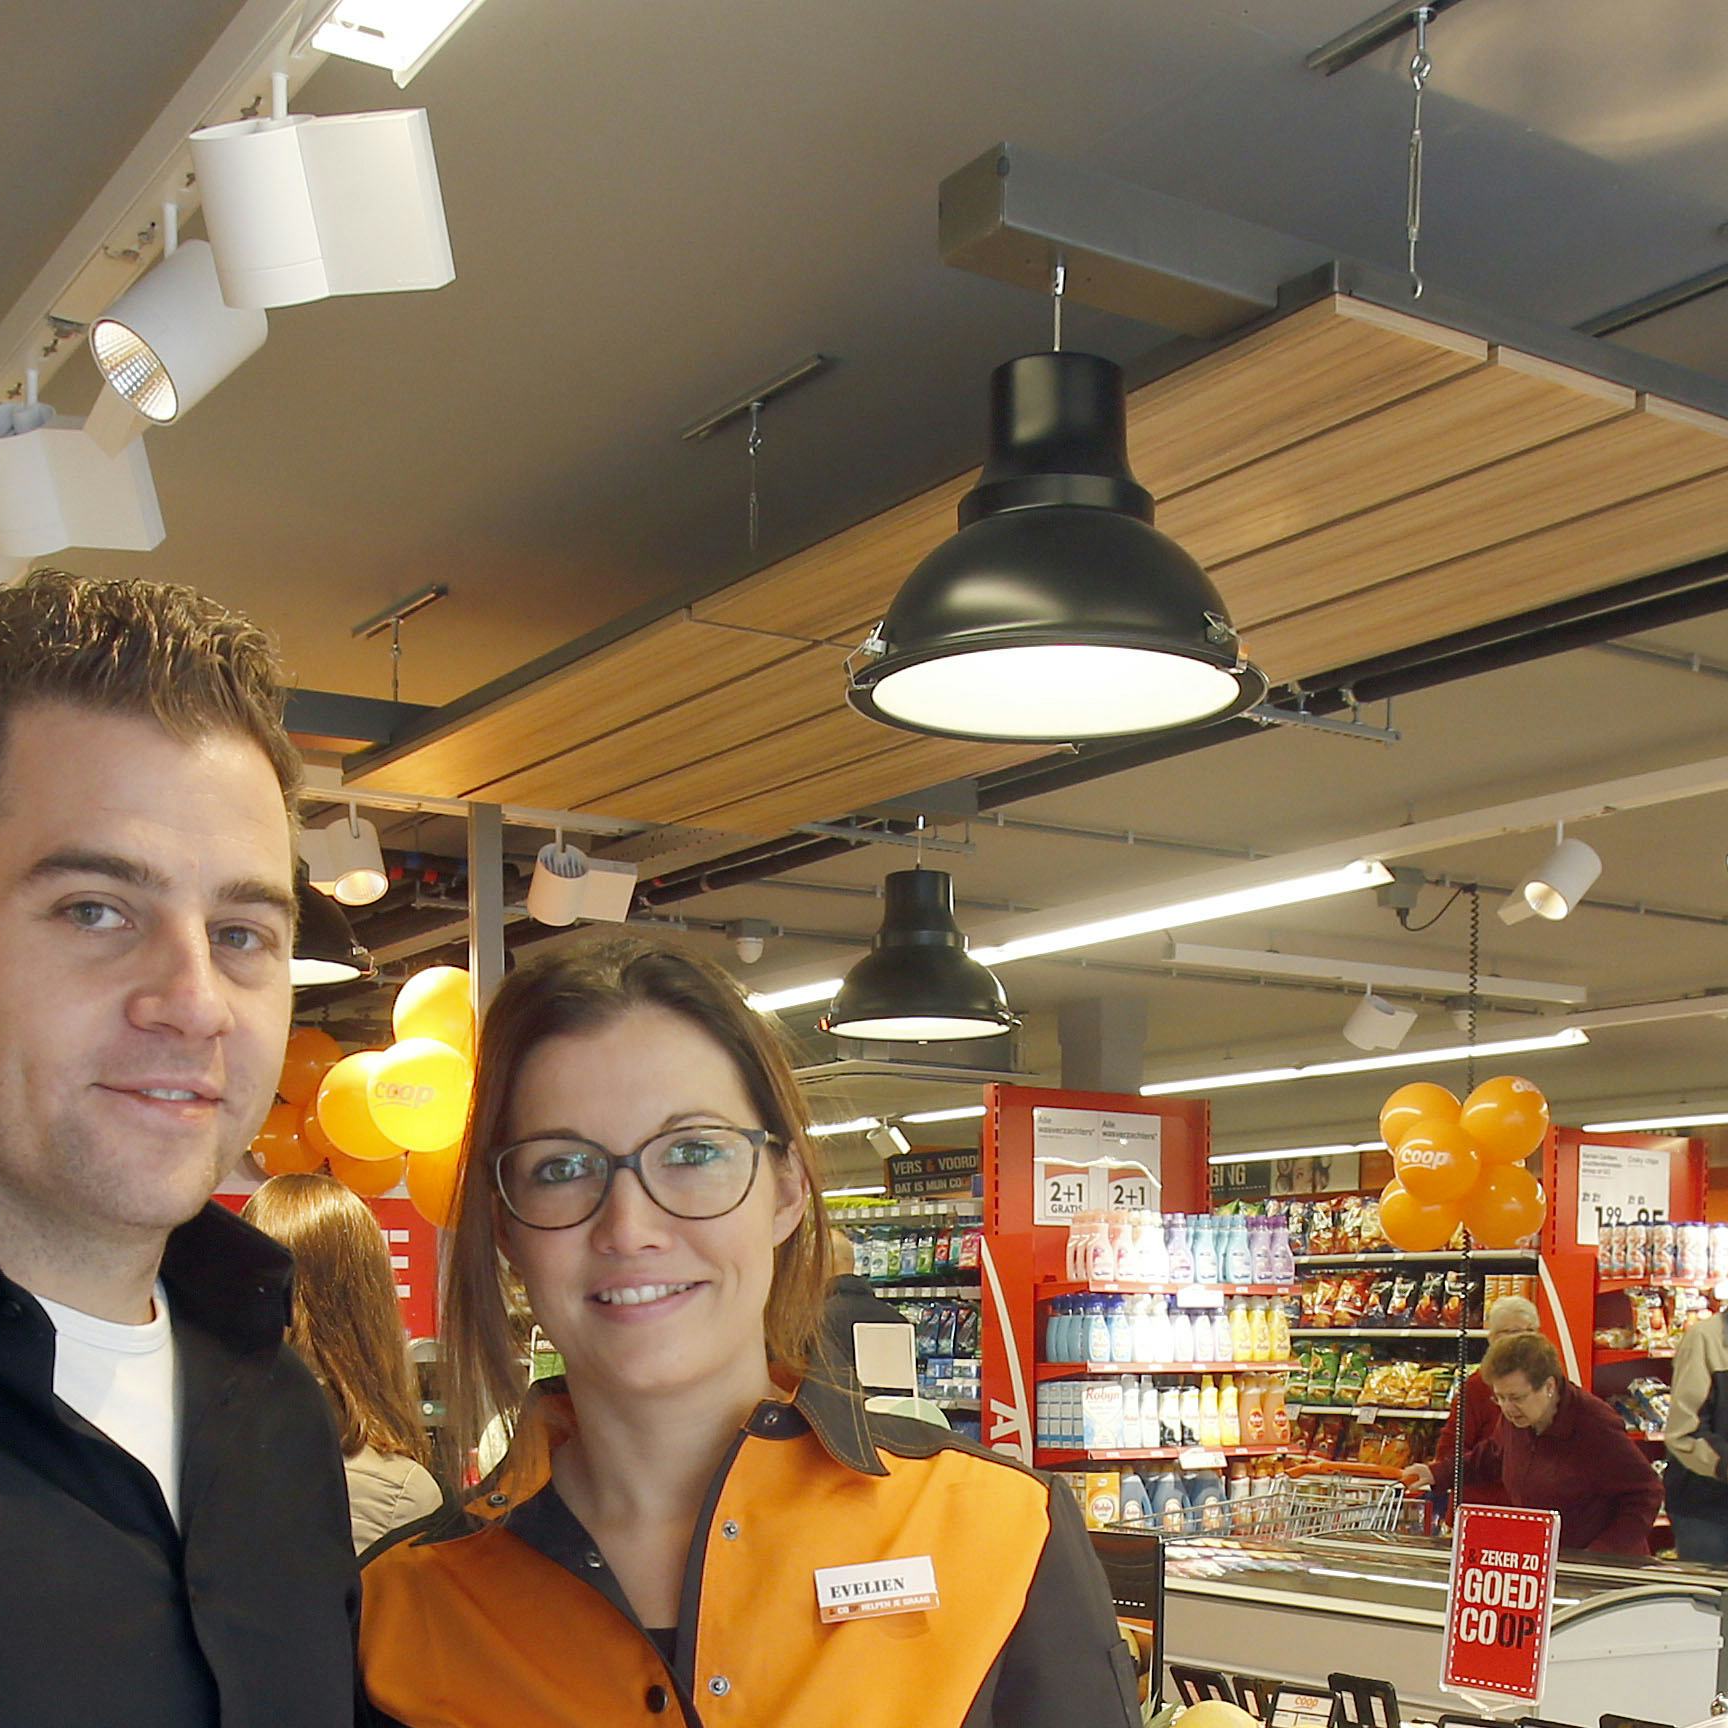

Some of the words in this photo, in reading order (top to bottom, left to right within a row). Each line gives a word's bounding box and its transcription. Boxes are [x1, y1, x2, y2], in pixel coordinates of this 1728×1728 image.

[375, 1080, 434, 1109] coop
[1102, 1120, 1115, 1128] Alle
[893, 1160, 922, 1175] VERS
[1399, 1148, 1453, 1171] coop
[894, 1182, 912, 1194] DAT
[914, 1181, 924, 1192] IS
[926, 1179, 948, 1191] MIJN
[1049, 1181, 1083, 1203] 2+1
[1112, 1184, 1146, 1206] 2+1
[1480, 1549, 1518, 1569] ZEKER
[1522, 1554, 1539, 1571] ZO
[830, 1577, 905, 1599] EVELIEN
[1463, 1567, 1539, 1611] GOED
[861, 1600, 891, 1611] HELPEN
[1459, 1606, 1536, 1650] COOP
[1294, 1696, 1319, 1709] coop
